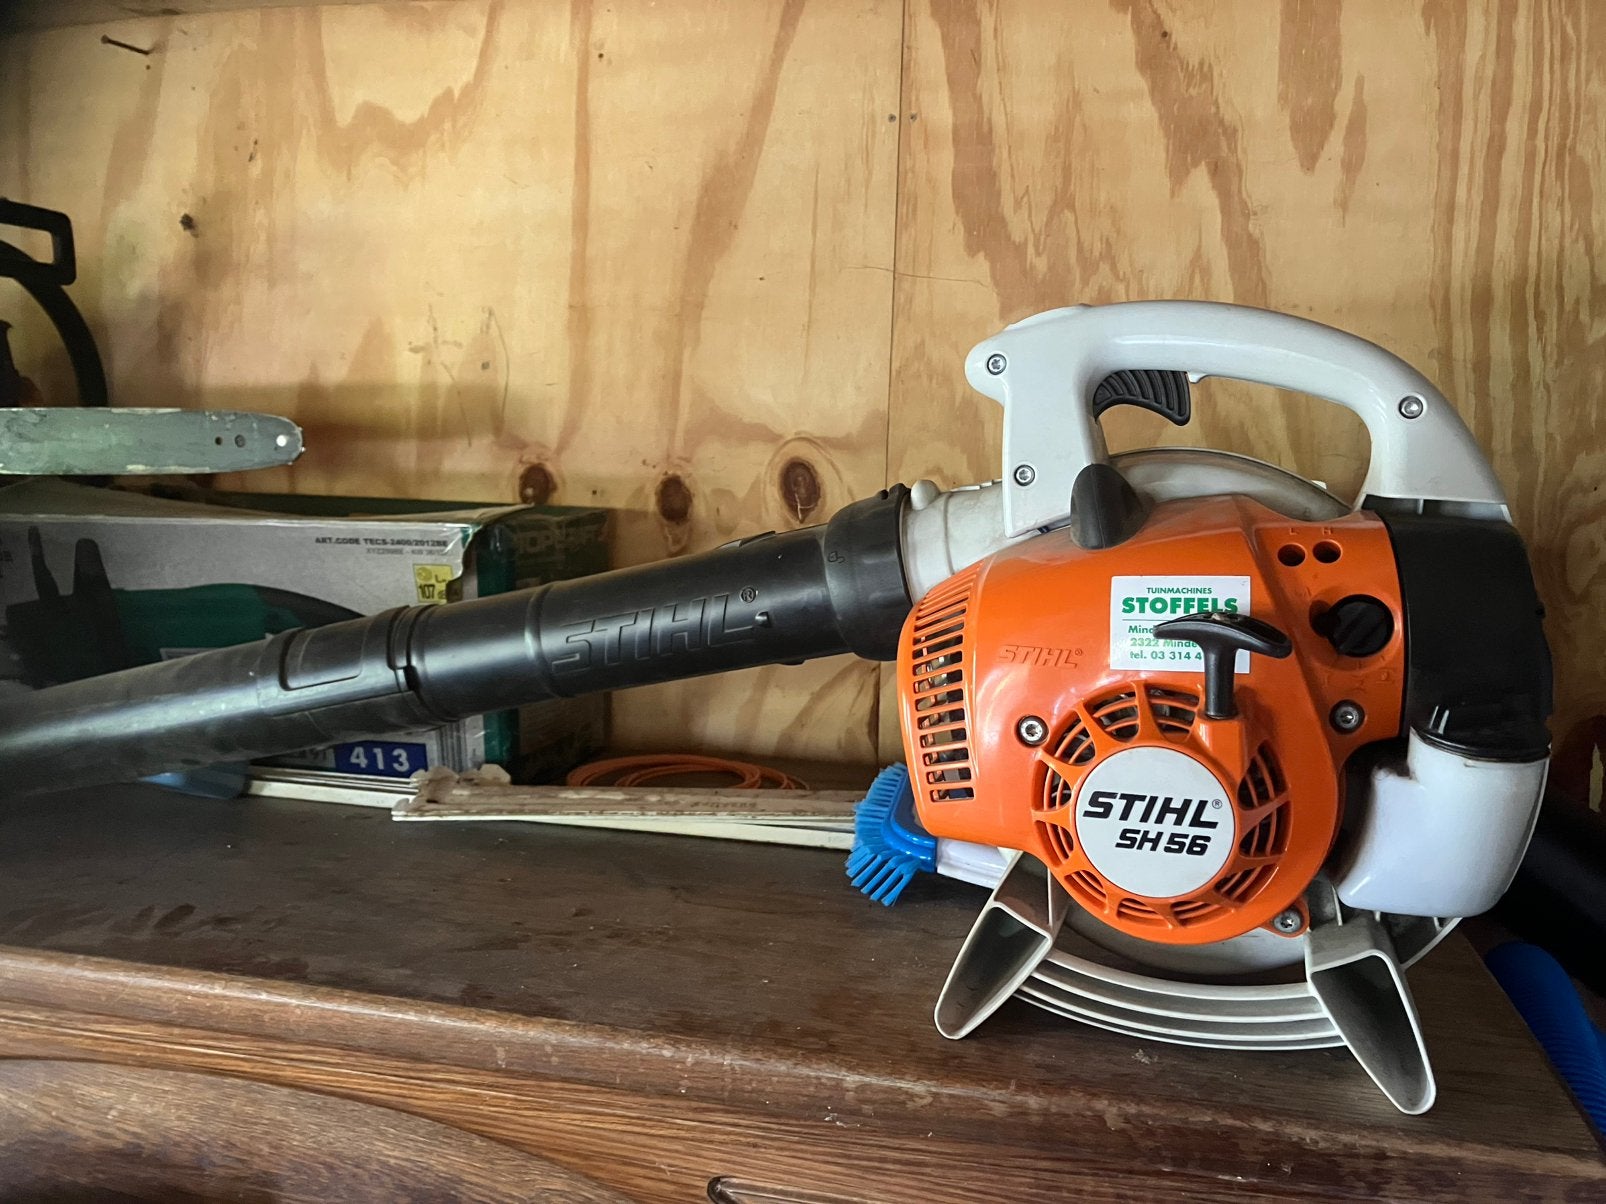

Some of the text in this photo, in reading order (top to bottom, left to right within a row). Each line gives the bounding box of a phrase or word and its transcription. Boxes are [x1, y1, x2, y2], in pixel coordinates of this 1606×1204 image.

[1122, 597, 1238, 614] STOFFELS
[1130, 638, 1160, 647] 2322
[1130, 650, 1147, 660] tel.
[1151, 651, 1165, 660] 03
[1169, 651, 1191, 660] 314
[350, 746, 410, 773] 413
[1115, 828, 1212, 856] SH 56
